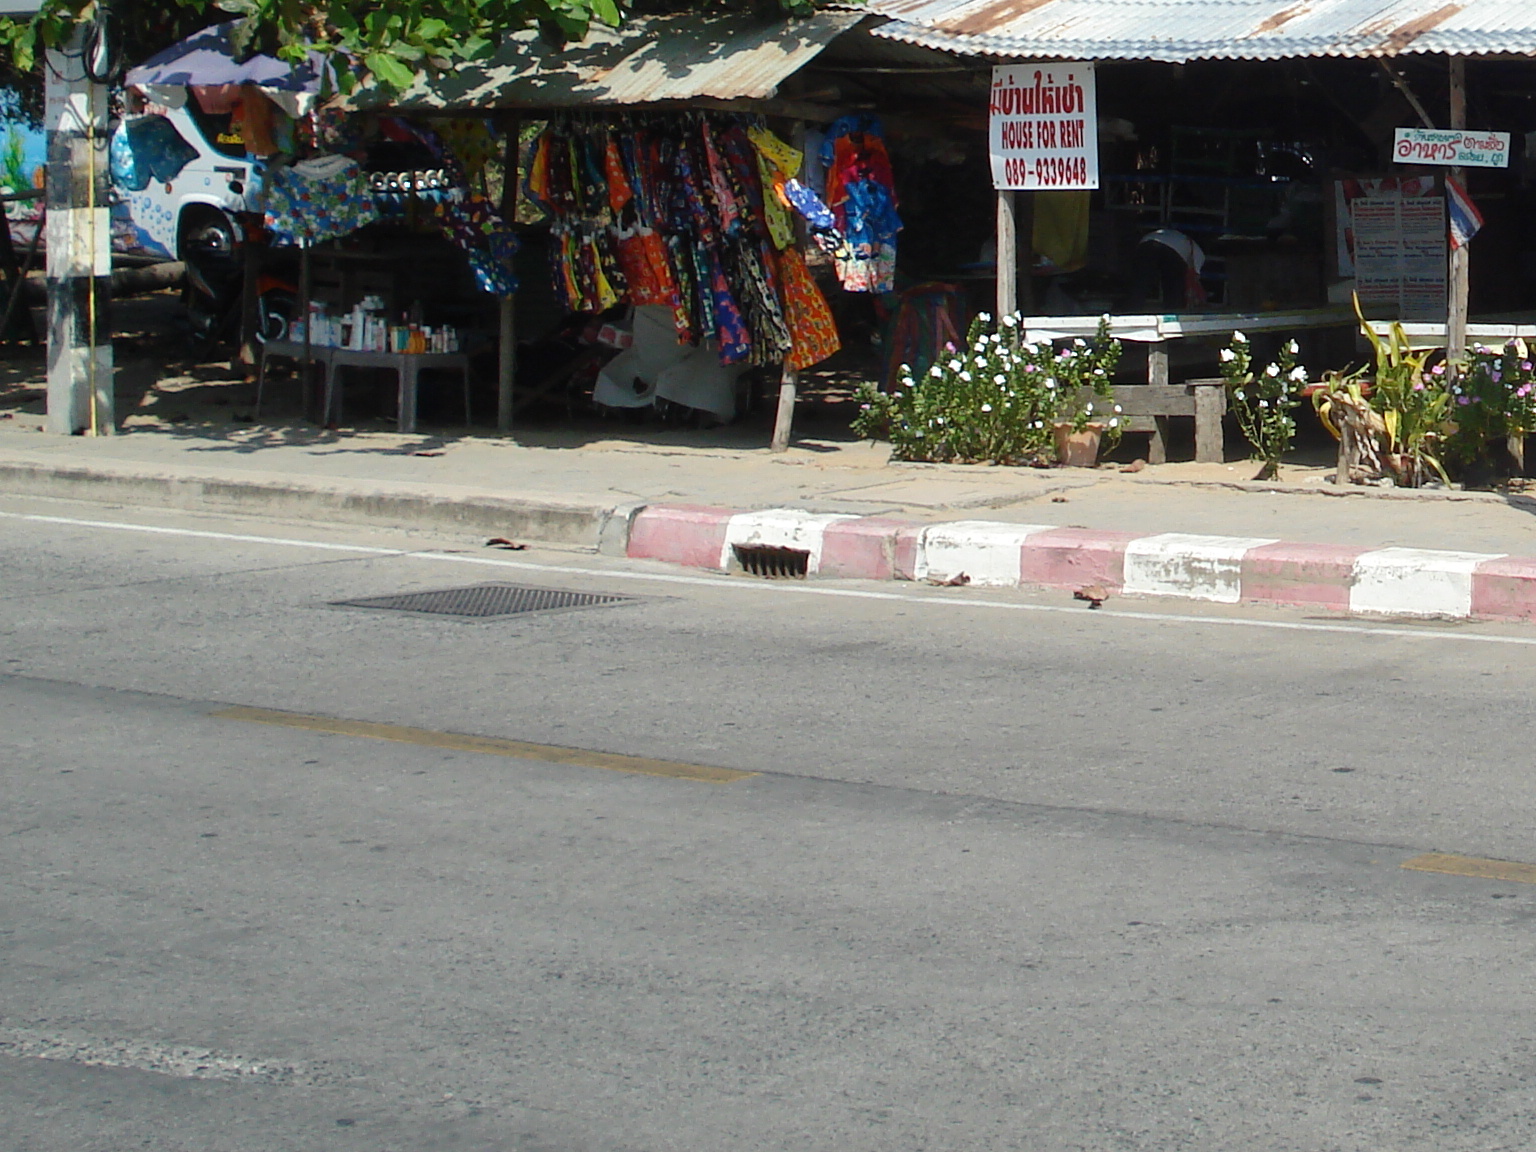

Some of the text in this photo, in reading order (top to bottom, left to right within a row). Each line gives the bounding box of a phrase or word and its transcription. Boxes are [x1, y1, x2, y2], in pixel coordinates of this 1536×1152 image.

[989, 70, 1084, 116] มีบ้านให้เช่า
[1002, 119, 1084, 149] HOUSE FOR RENT
[1005, 157, 1086, 186] 089-9339648
